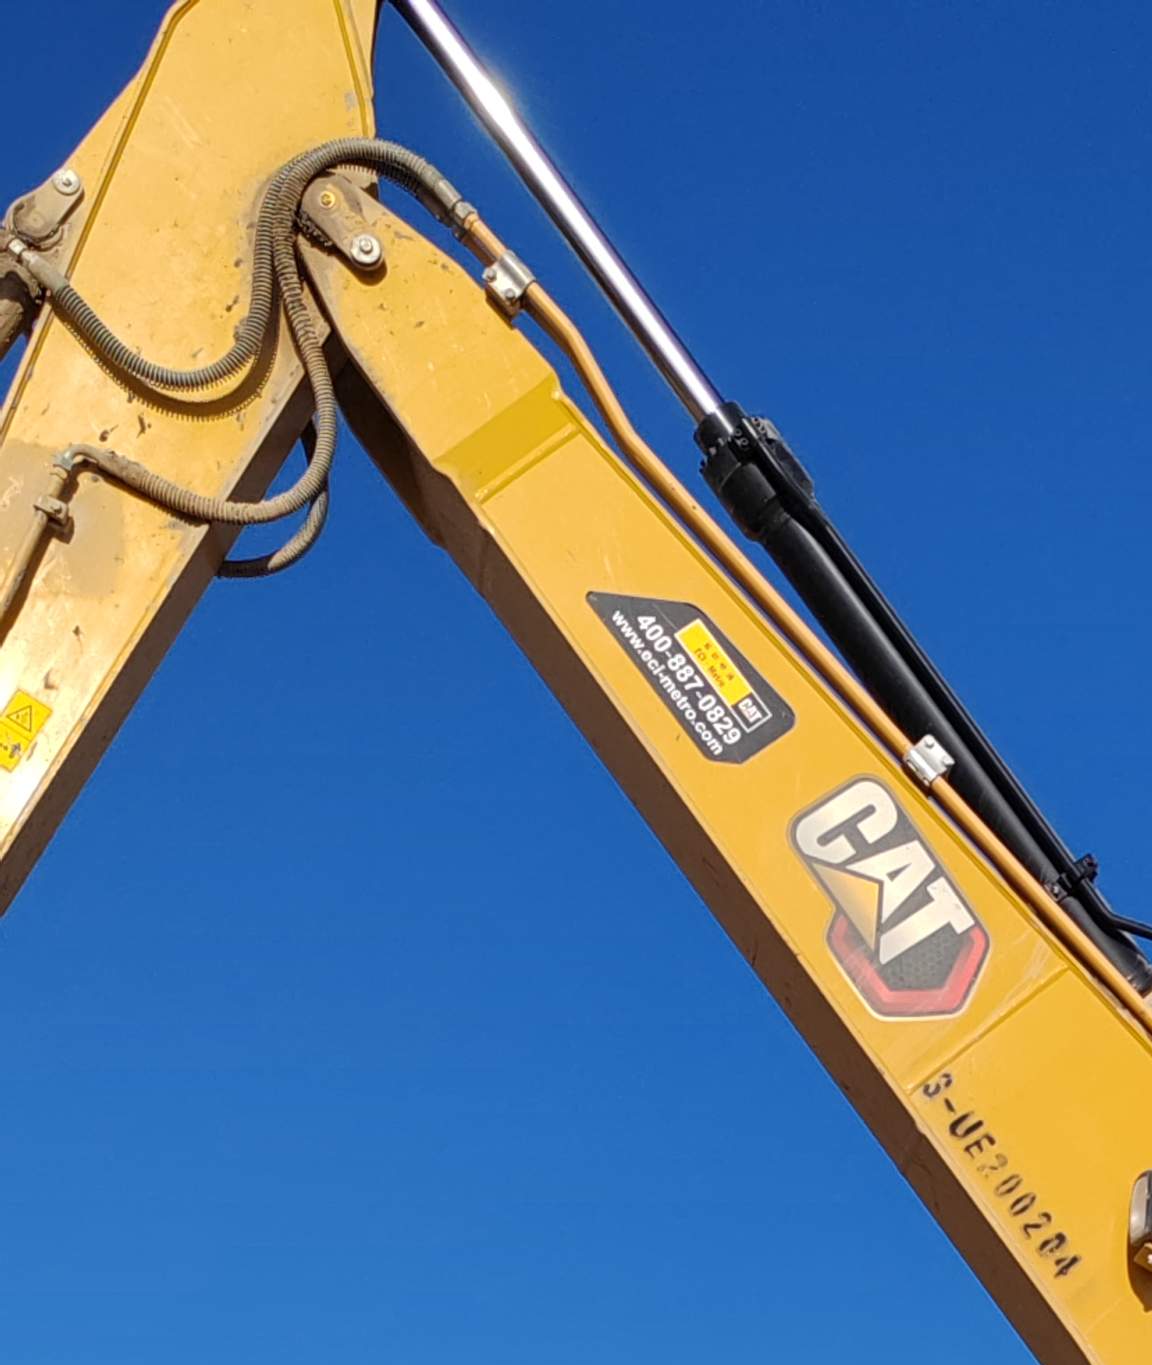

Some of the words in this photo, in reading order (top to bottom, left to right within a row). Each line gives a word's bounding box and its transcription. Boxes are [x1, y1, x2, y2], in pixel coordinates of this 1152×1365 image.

[637, 615, 742, 746] 400-887-0829
[738, 697, 763, 723] CAT
[795, 779, 975, 966] CAT
